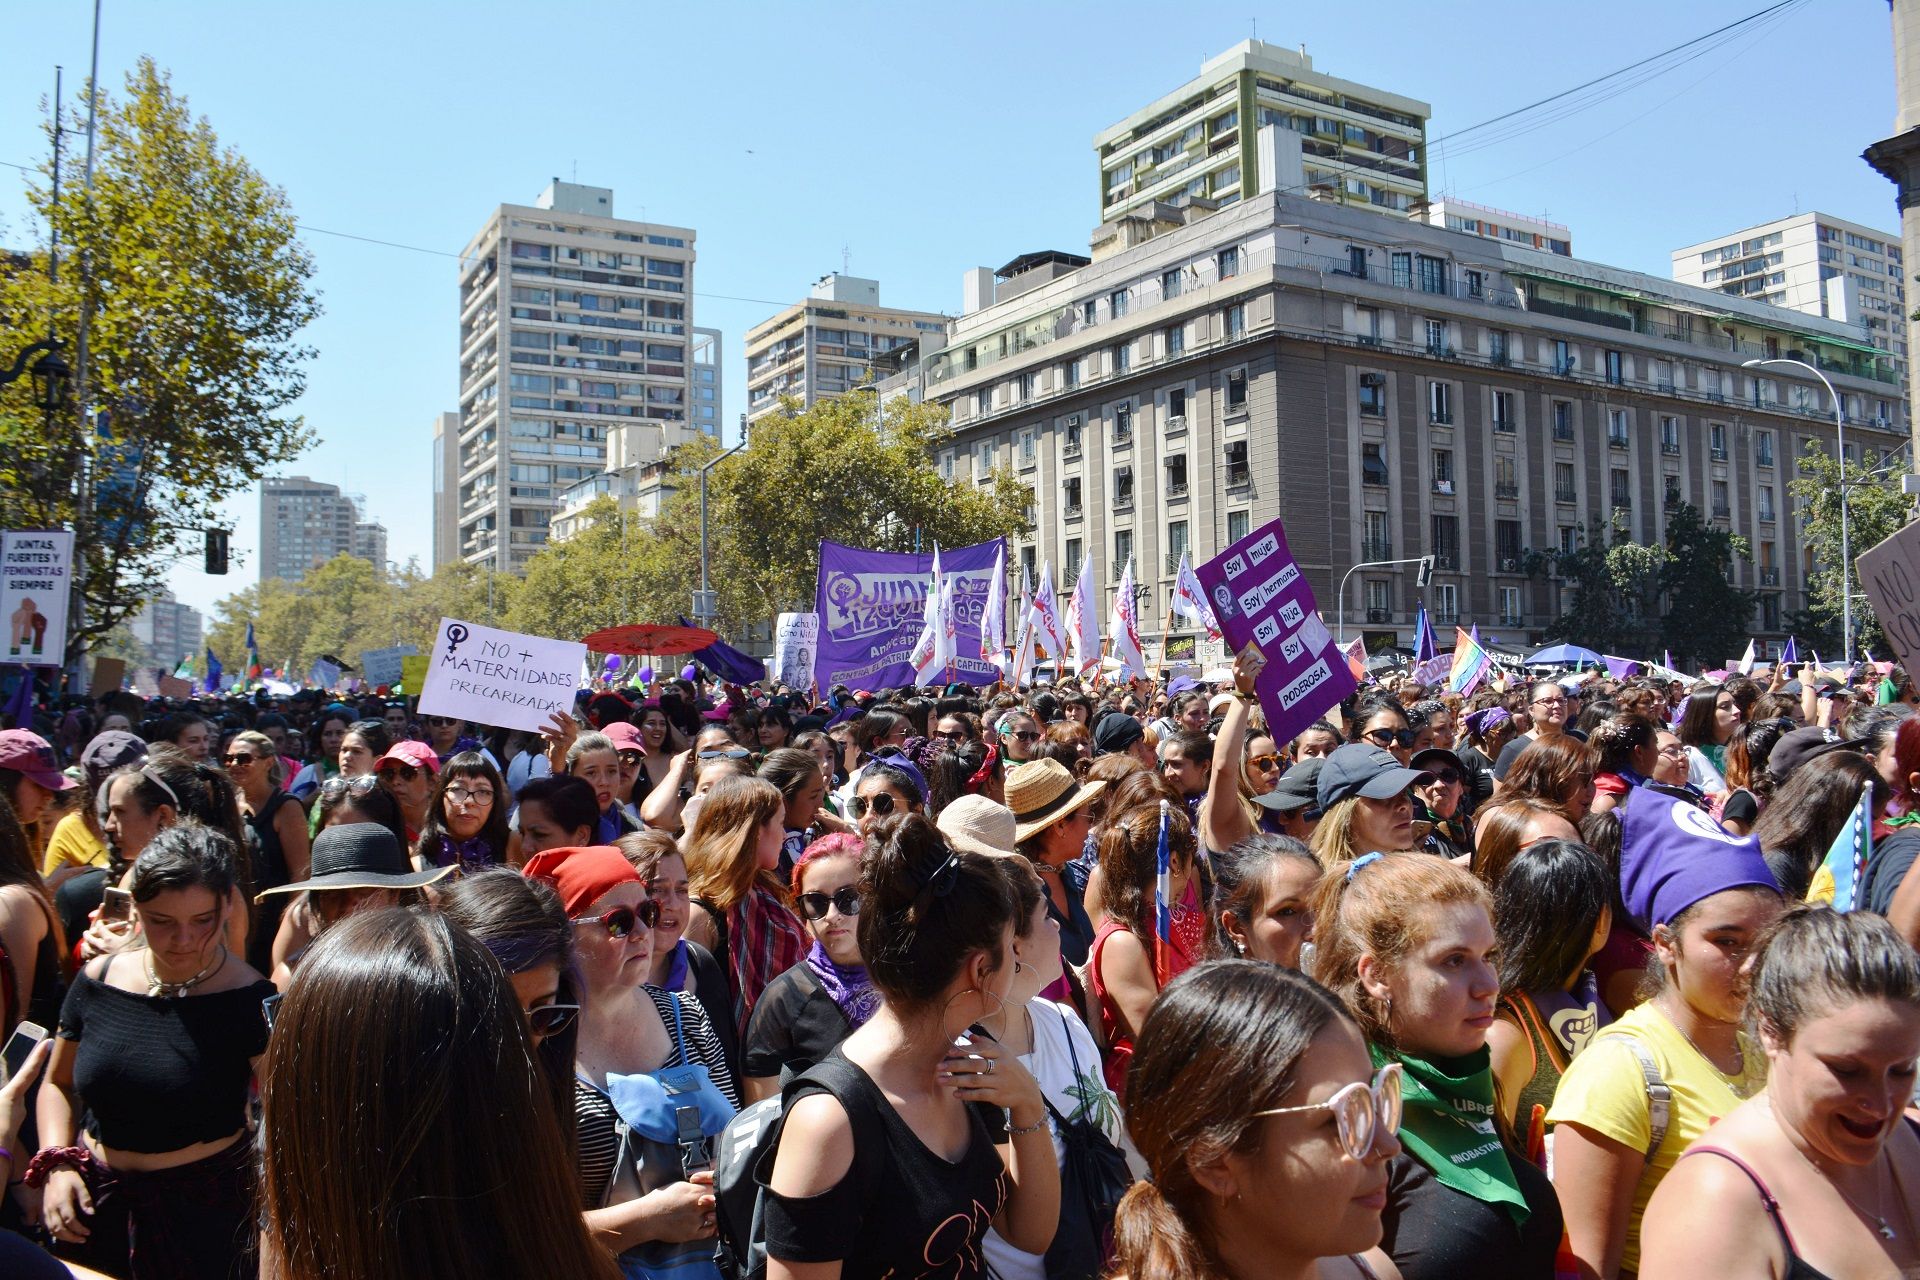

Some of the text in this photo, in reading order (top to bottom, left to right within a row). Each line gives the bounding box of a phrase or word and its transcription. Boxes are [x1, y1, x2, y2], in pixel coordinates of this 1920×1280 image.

[13, 540, 56, 551] JUNTAS,
[1250, 540, 1274, 561] mujer
[7, 553, 61, 563] FUERTES Y
[3, 566, 63, 576] FEMINISTAS
[9, 580, 54, 591] SIEMPRE
[1265, 568, 1297, 595] hermana
[1874, 560, 1914, 615] NO
[1283, 604, 1300, 621] hija
[481, 640, 533, 663] NO +
[441, 654, 572, 687] MATERNIDADES
[832, 669, 869, 682] CONTRA
[872, 663, 880, 672] EL
[957, 660, 994, 672] CAPITAL
[450, 678, 565, 713] PRECARIZADAS
[1282, 666, 1327, 706] PODEROSA
[1453, 1098, 1494, 1115] LIBRE
